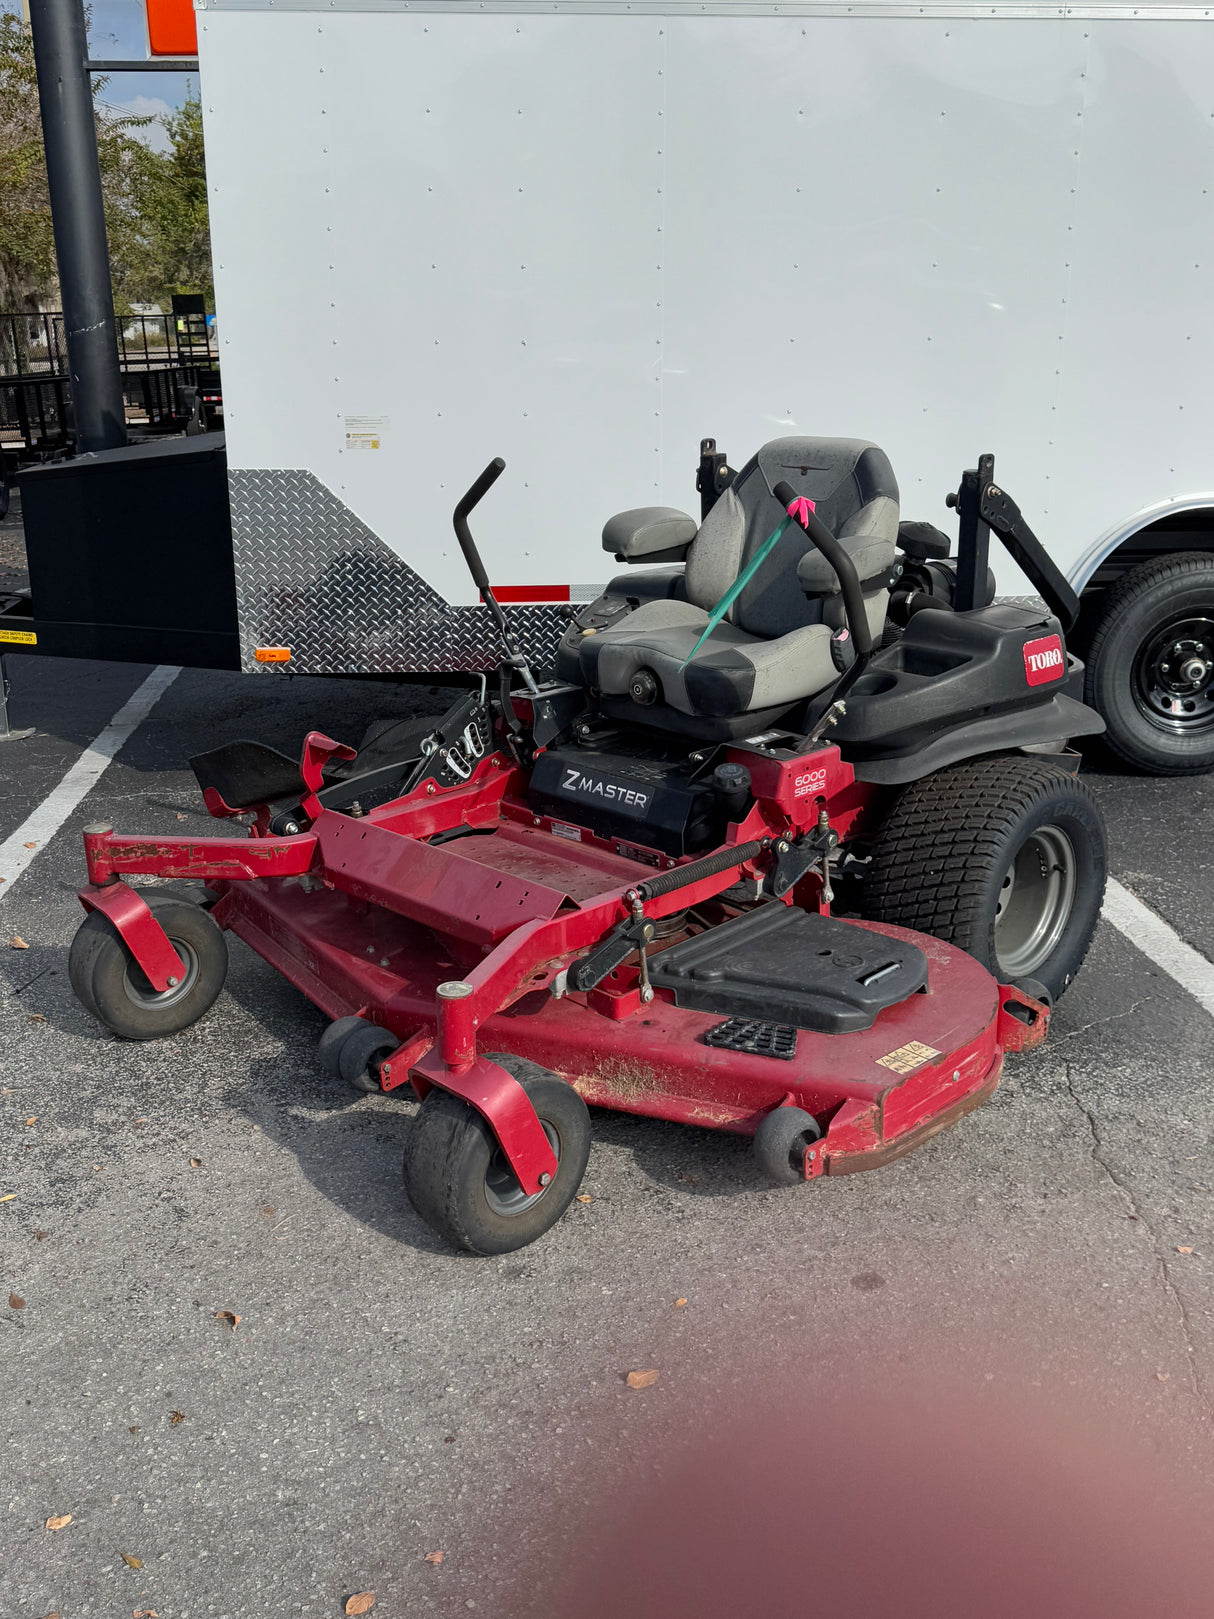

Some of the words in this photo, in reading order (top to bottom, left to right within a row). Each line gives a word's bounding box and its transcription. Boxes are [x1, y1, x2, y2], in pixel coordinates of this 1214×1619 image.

[1028, 648, 1063, 672] TORO
[794, 768, 826, 787] 6000
[562, 769, 581, 791] Z
[578, 777, 647, 808] MASTER
[794, 780, 825, 798] SERIES
